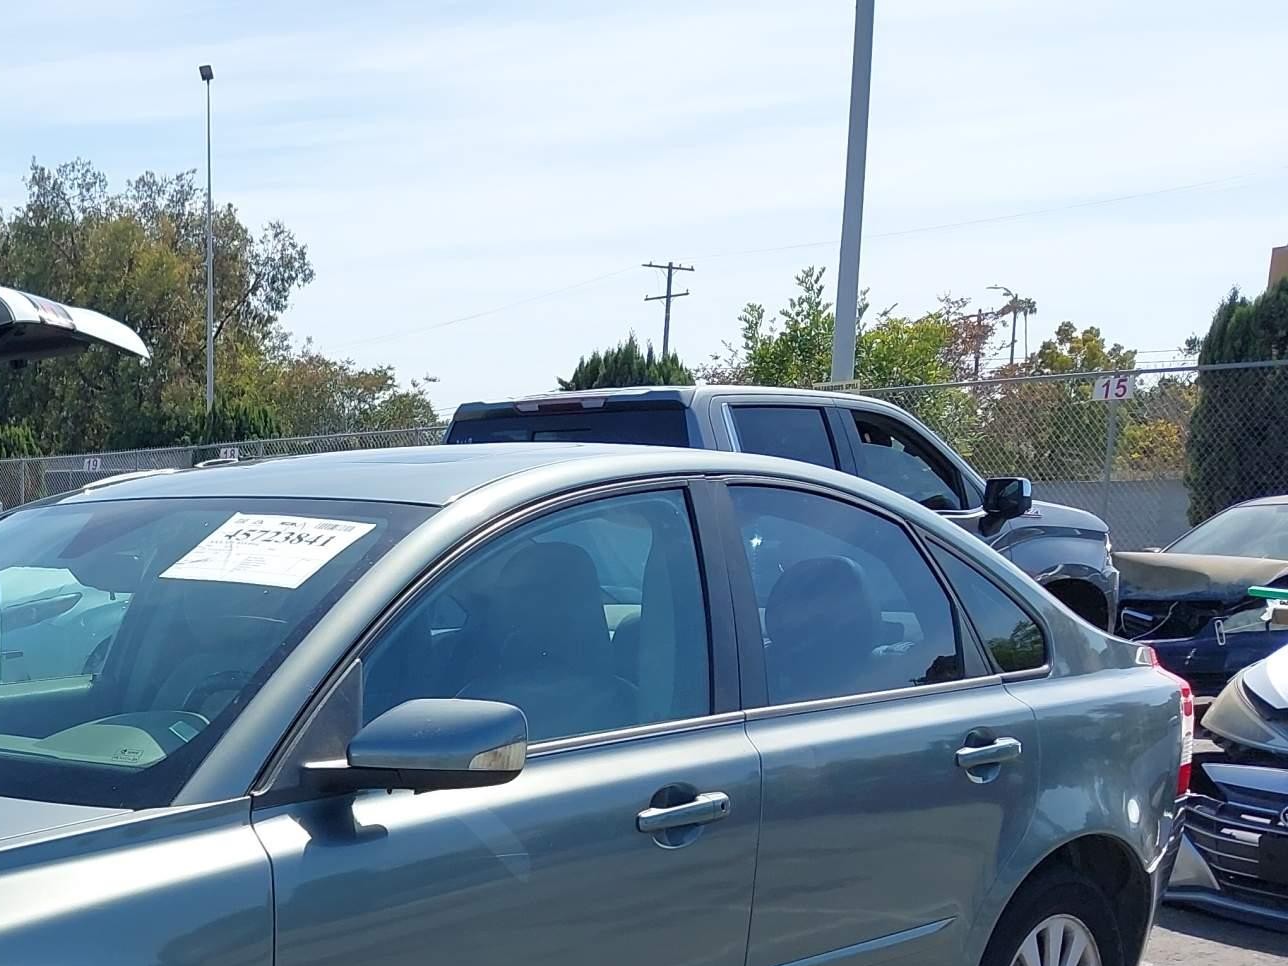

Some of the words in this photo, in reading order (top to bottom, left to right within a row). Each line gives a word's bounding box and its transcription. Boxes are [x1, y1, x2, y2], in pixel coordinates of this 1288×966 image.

[1101, 379, 1129, 399] 15
[87, 459, 98, 470] 19
[224, 529, 336, 547] 45723841
